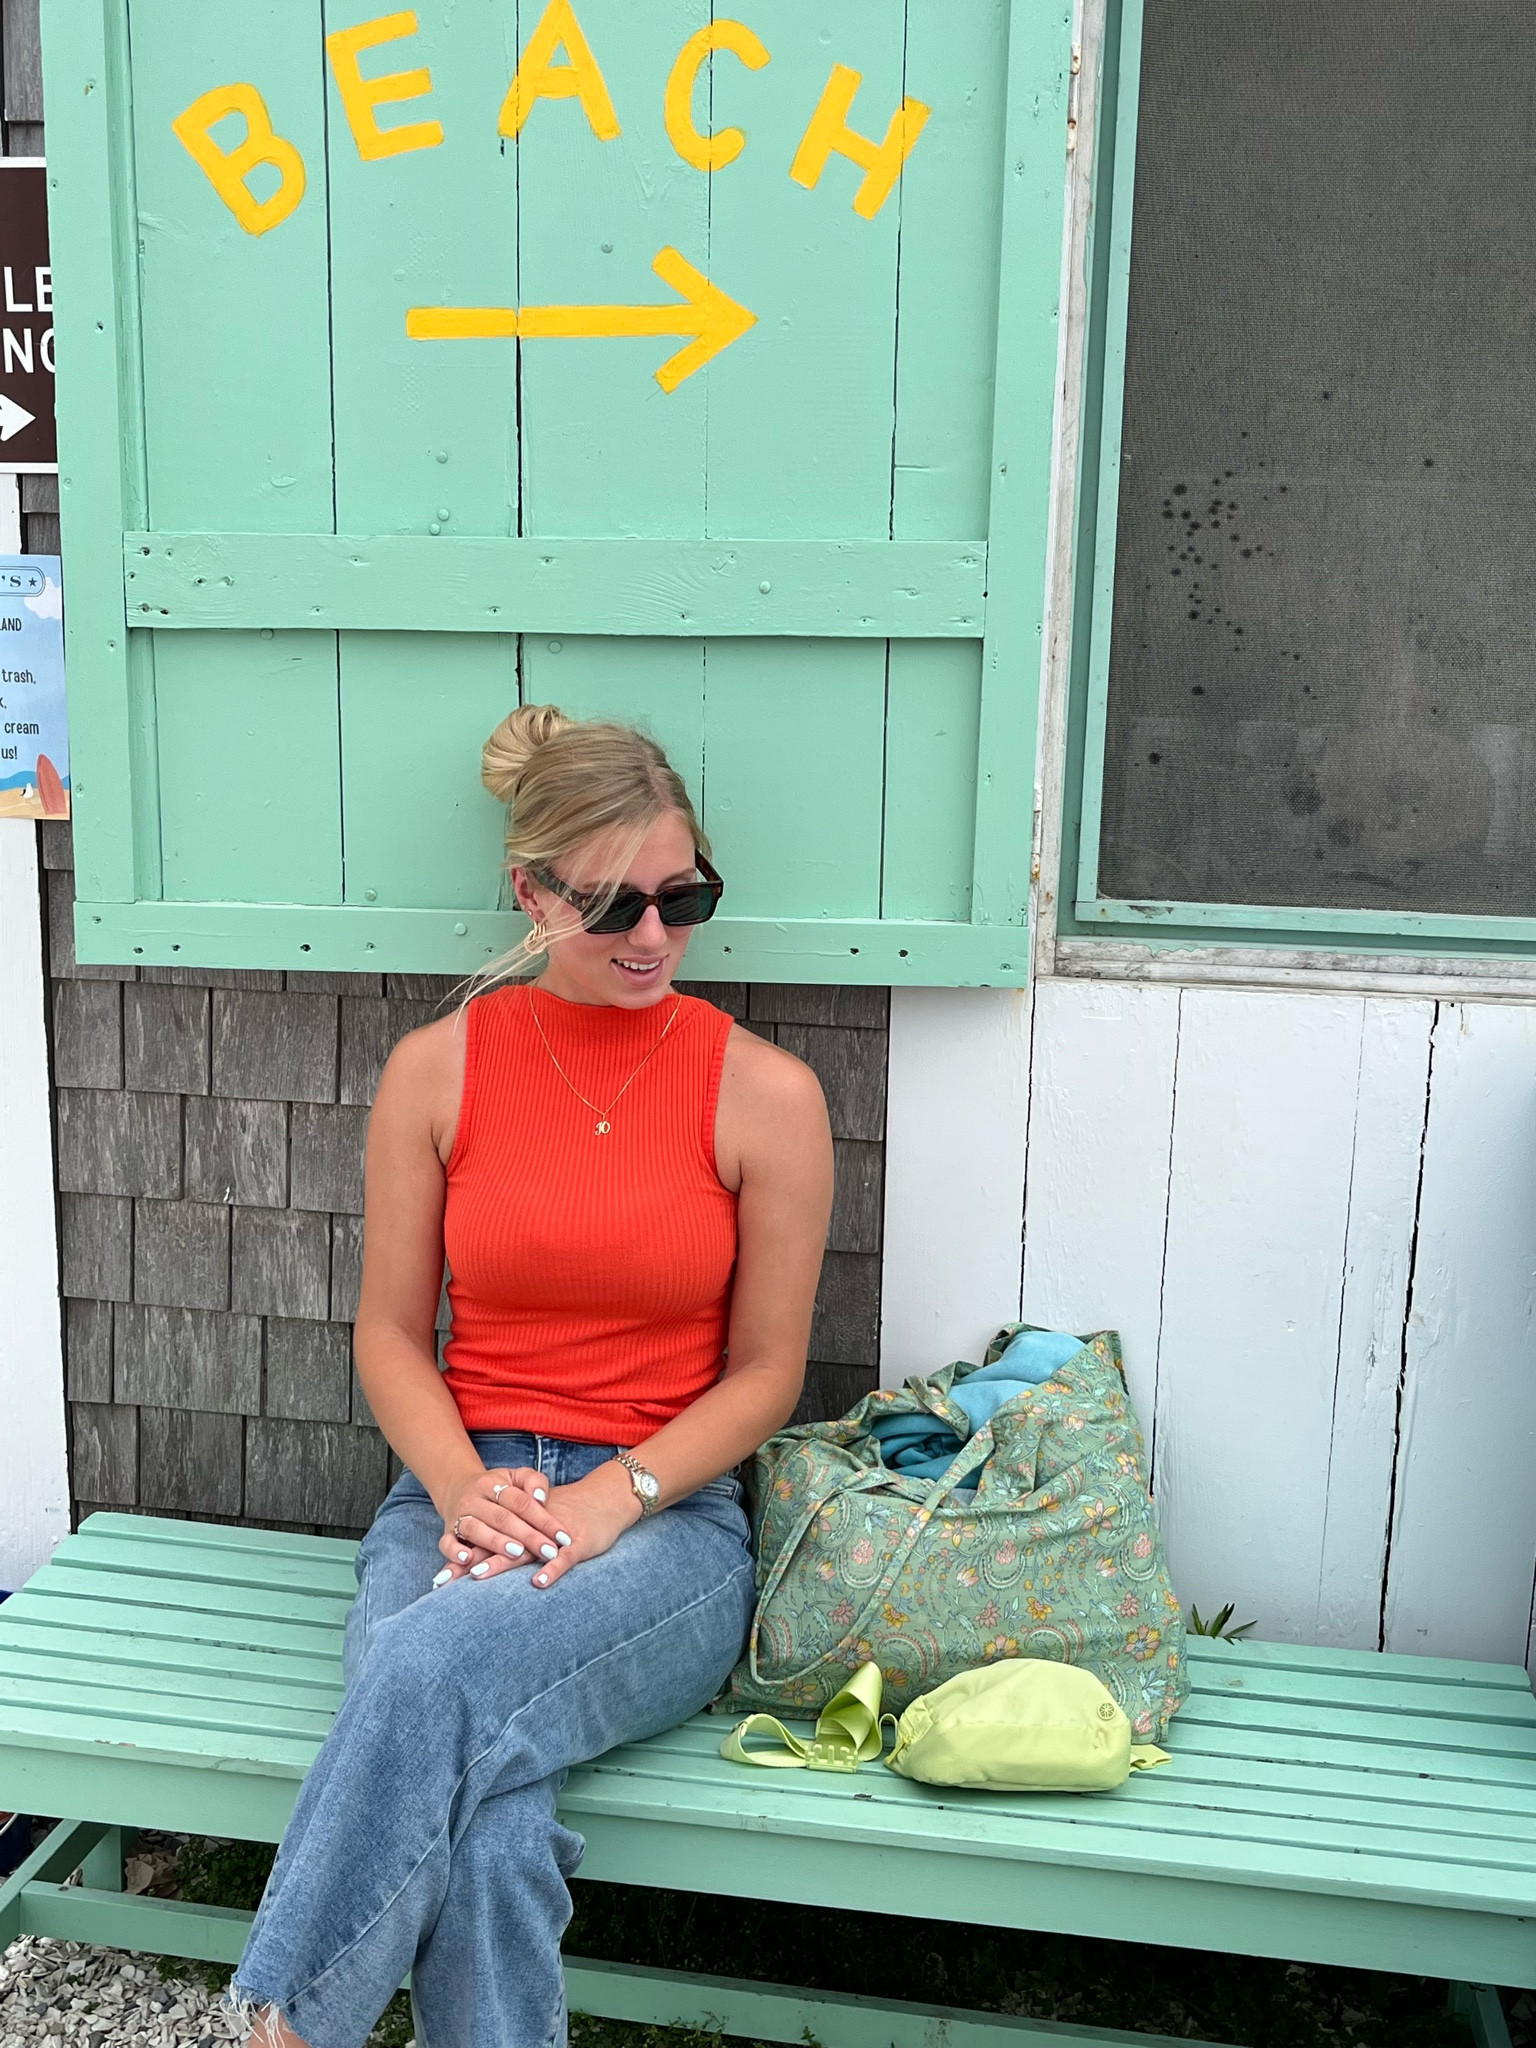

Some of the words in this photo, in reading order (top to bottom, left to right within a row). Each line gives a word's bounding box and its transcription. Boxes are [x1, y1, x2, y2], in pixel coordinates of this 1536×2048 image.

[172, 0, 931, 237] BEACH
[0, 617, 22, 631] AND
[5, 722, 39, 735] cream
[1, 746, 18, 760] us!
